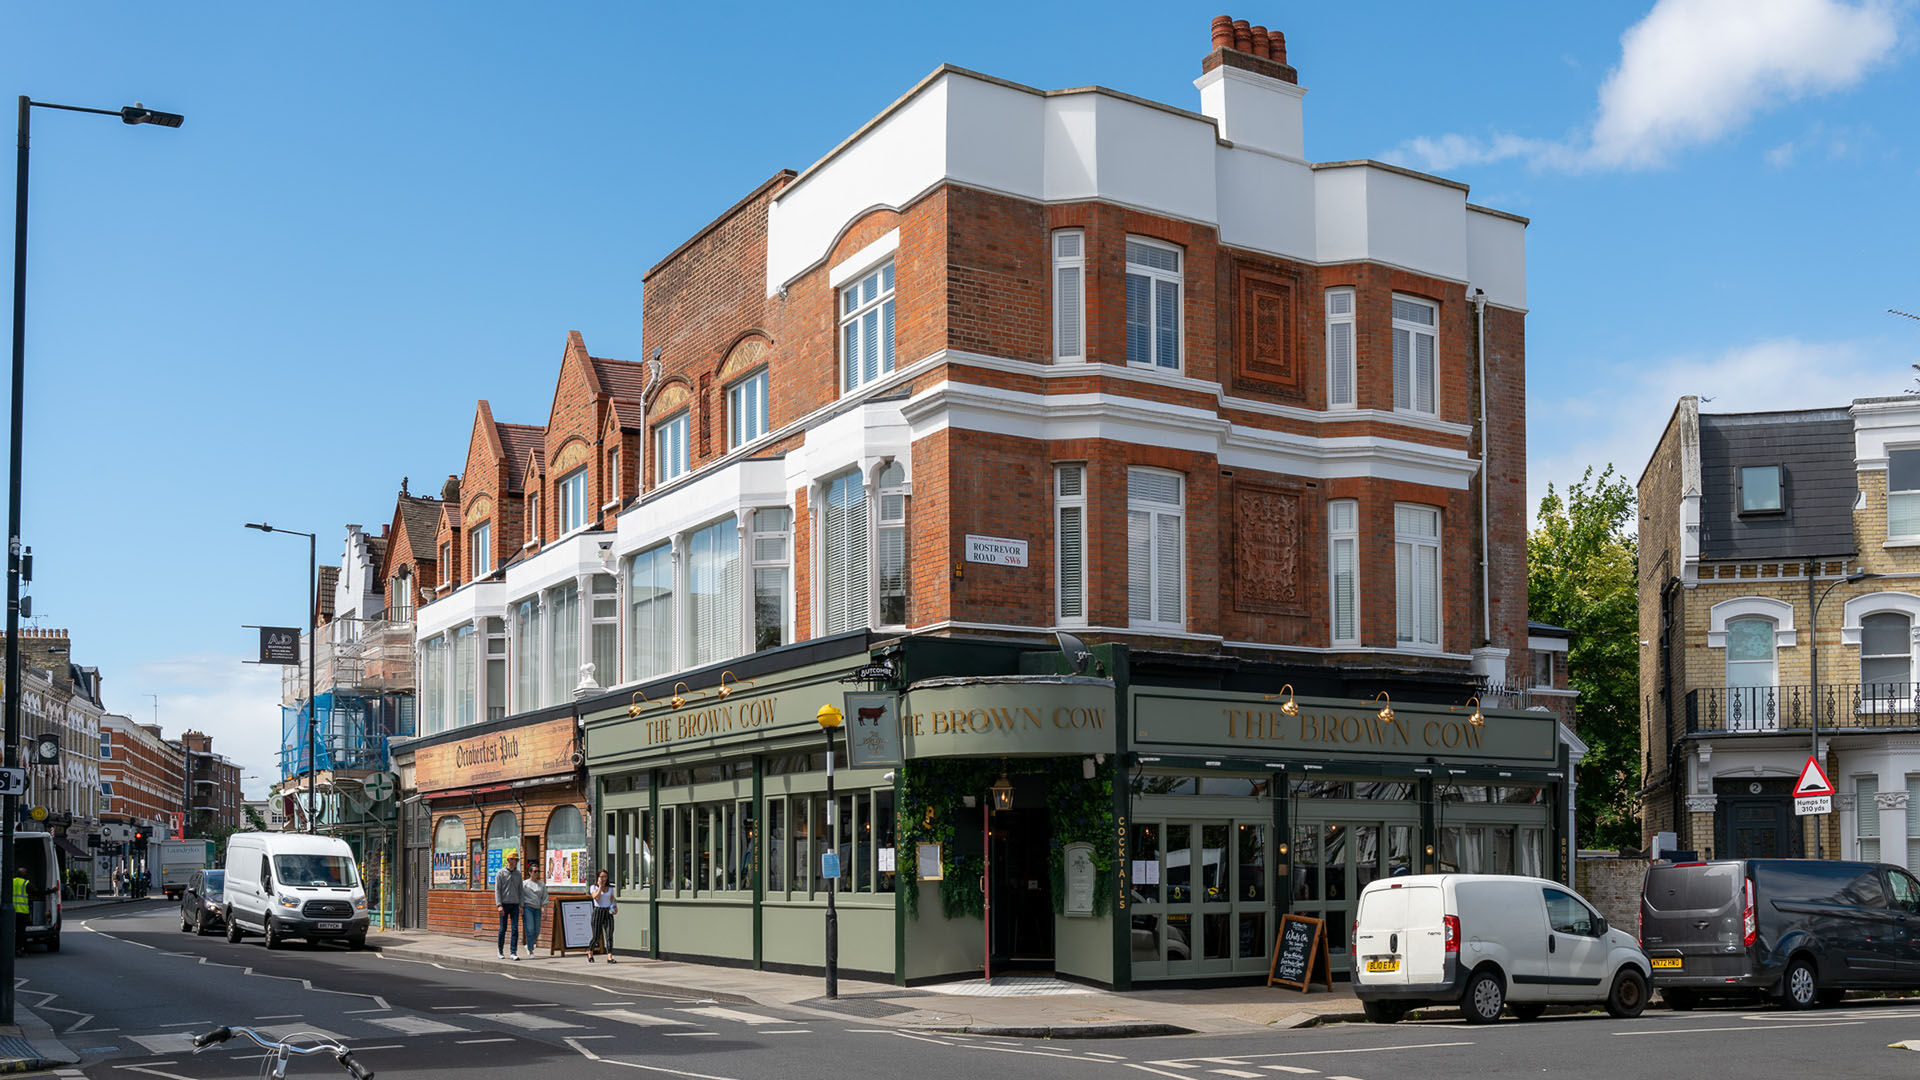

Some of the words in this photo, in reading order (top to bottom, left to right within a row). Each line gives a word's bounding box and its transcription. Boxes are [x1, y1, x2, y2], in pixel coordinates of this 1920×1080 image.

[973, 543, 1021, 555] ROSTREVOR
[973, 553, 996, 562] ROAD
[1004, 555, 1021, 564] SW6
[645, 717, 672, 745] THE
[677, 706, 733, 740] BROWN
[739, 696, 778, 729] COW
[931, 706, 1043, 735] BROWN
[1053, 706, 1107, 730] COW
[1223, 708, 1286, 740] THE
[1300, 714, 1411, 745] BROWN
[1424, 720, 1488, 749] COW
[455, 741, 499, 769] Octoberfest
[499, 735, 520, 766] Pub
[1752, 784, 1759, 792] 2
[1118, 816, 1126, 909] COCKTAILS
[1383, 961, 1396, 969] ETX
